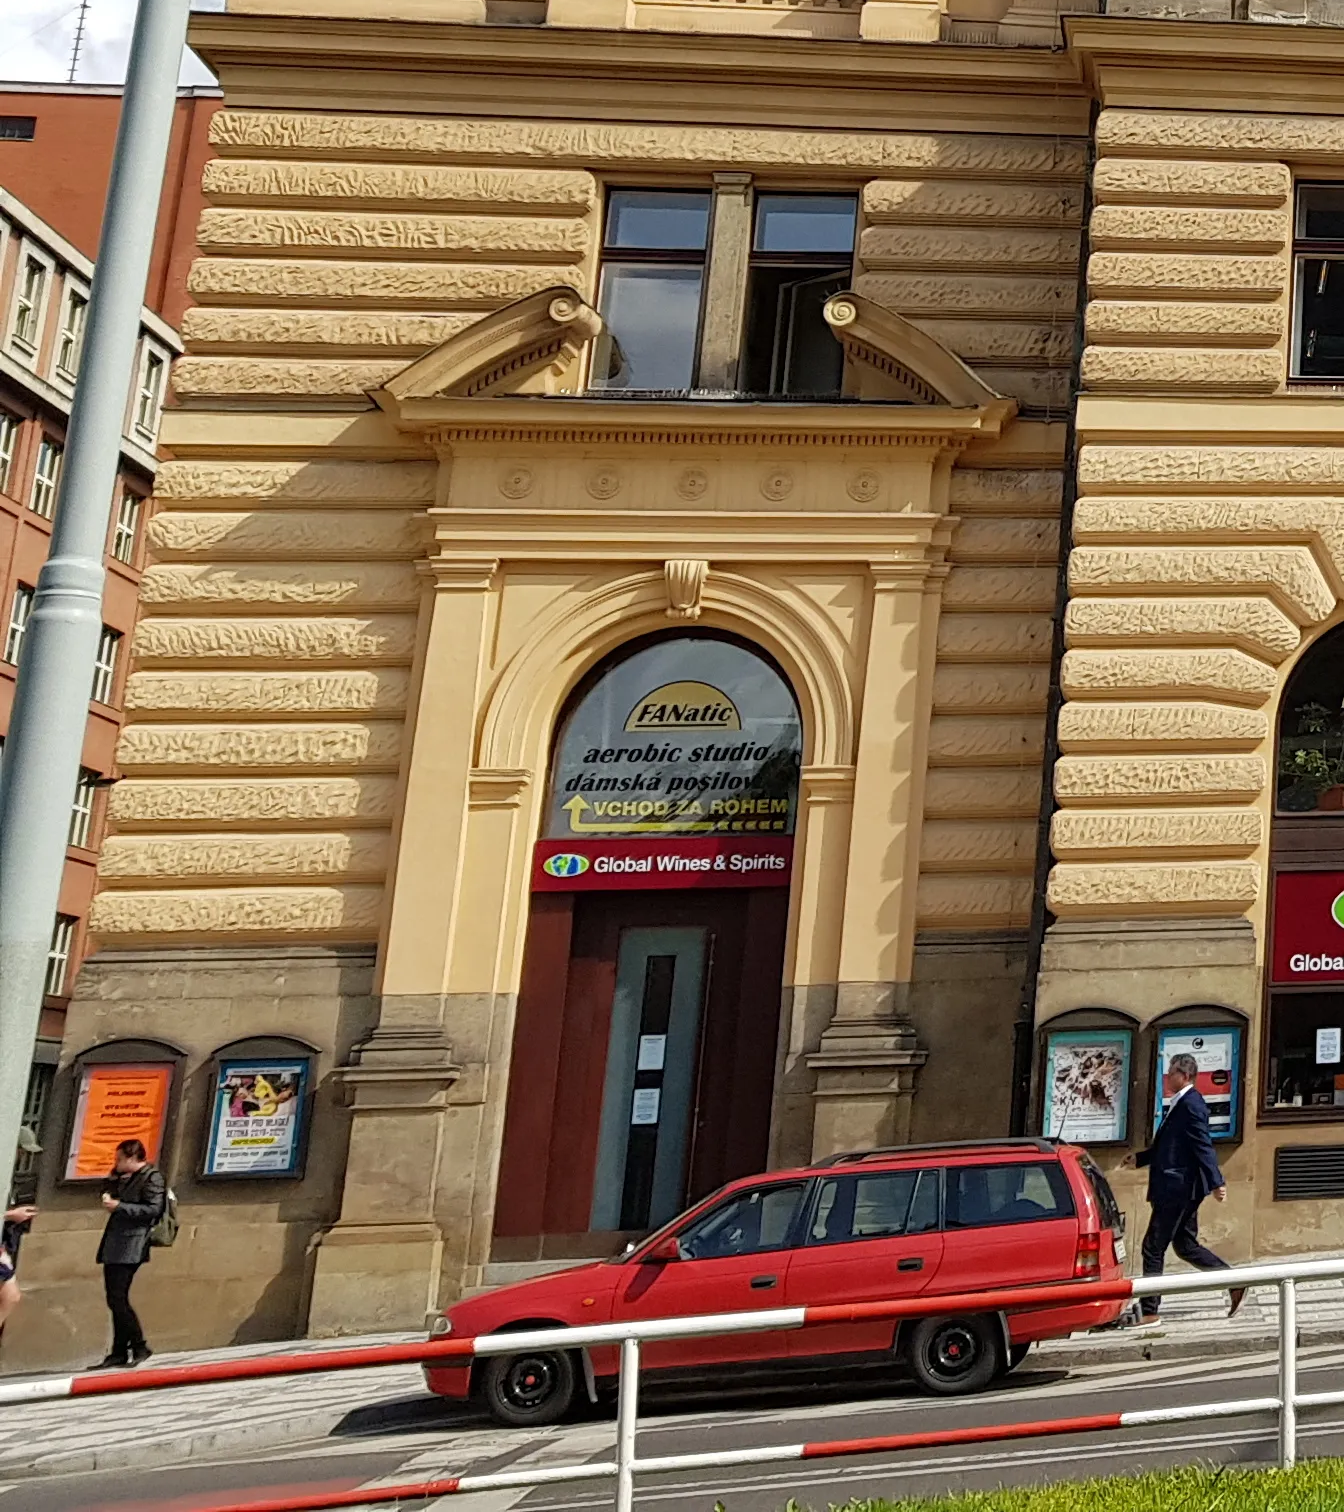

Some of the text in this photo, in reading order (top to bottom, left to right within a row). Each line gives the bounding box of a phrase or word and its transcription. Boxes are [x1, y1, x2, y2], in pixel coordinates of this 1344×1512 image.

[636, 702, 733, 723] FANatic
[583, 741, 770, 764] aerobic studio
[565, 771, 758, 795] dámská posilov
[593, 799, 788, 817] VCHOD ZA ROHEM
[594, 853, 786, 874] Global Wines & Spirits
